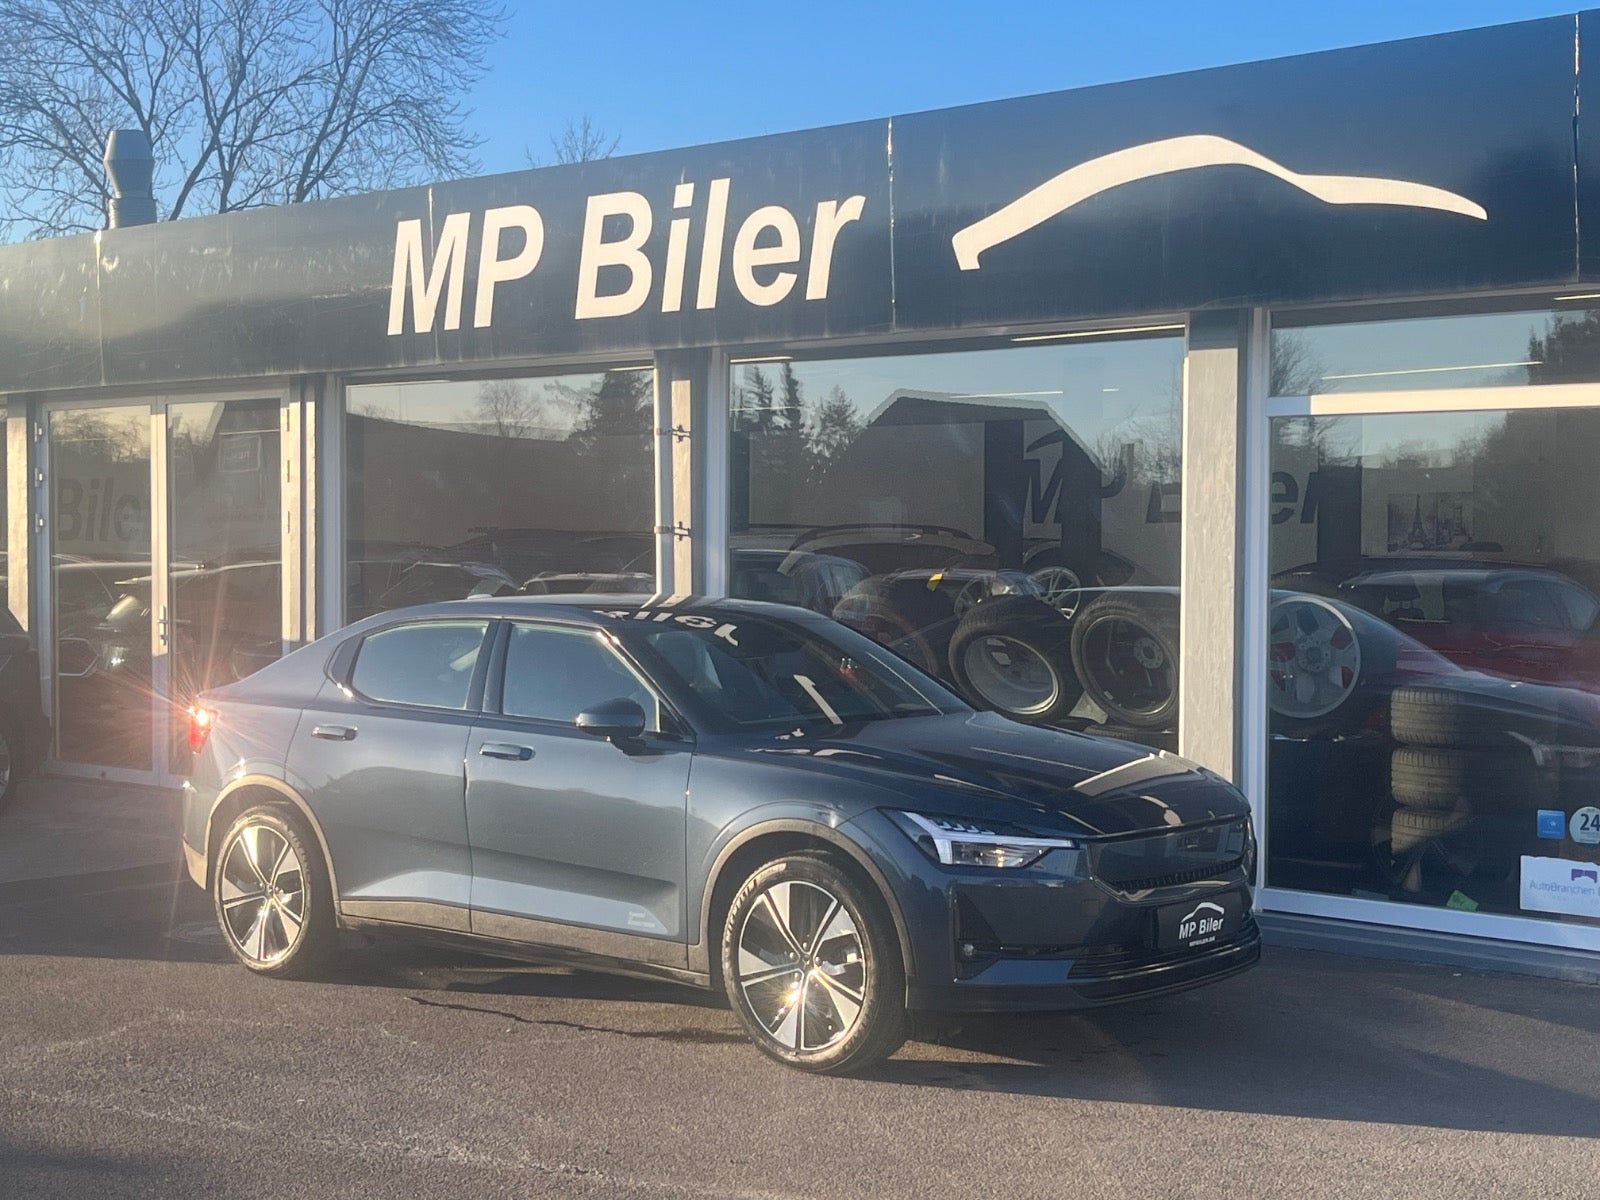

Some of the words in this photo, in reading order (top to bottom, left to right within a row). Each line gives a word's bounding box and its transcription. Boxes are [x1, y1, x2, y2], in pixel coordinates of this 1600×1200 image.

[387, 205, 544, 335] MP
[575, 178, 866, 320] Biler
[1529, 879, 1595, 895] AutoBranchen
[1178, 921, 1197, 940] MP
[1199, 917, 1224, 935] Biler
